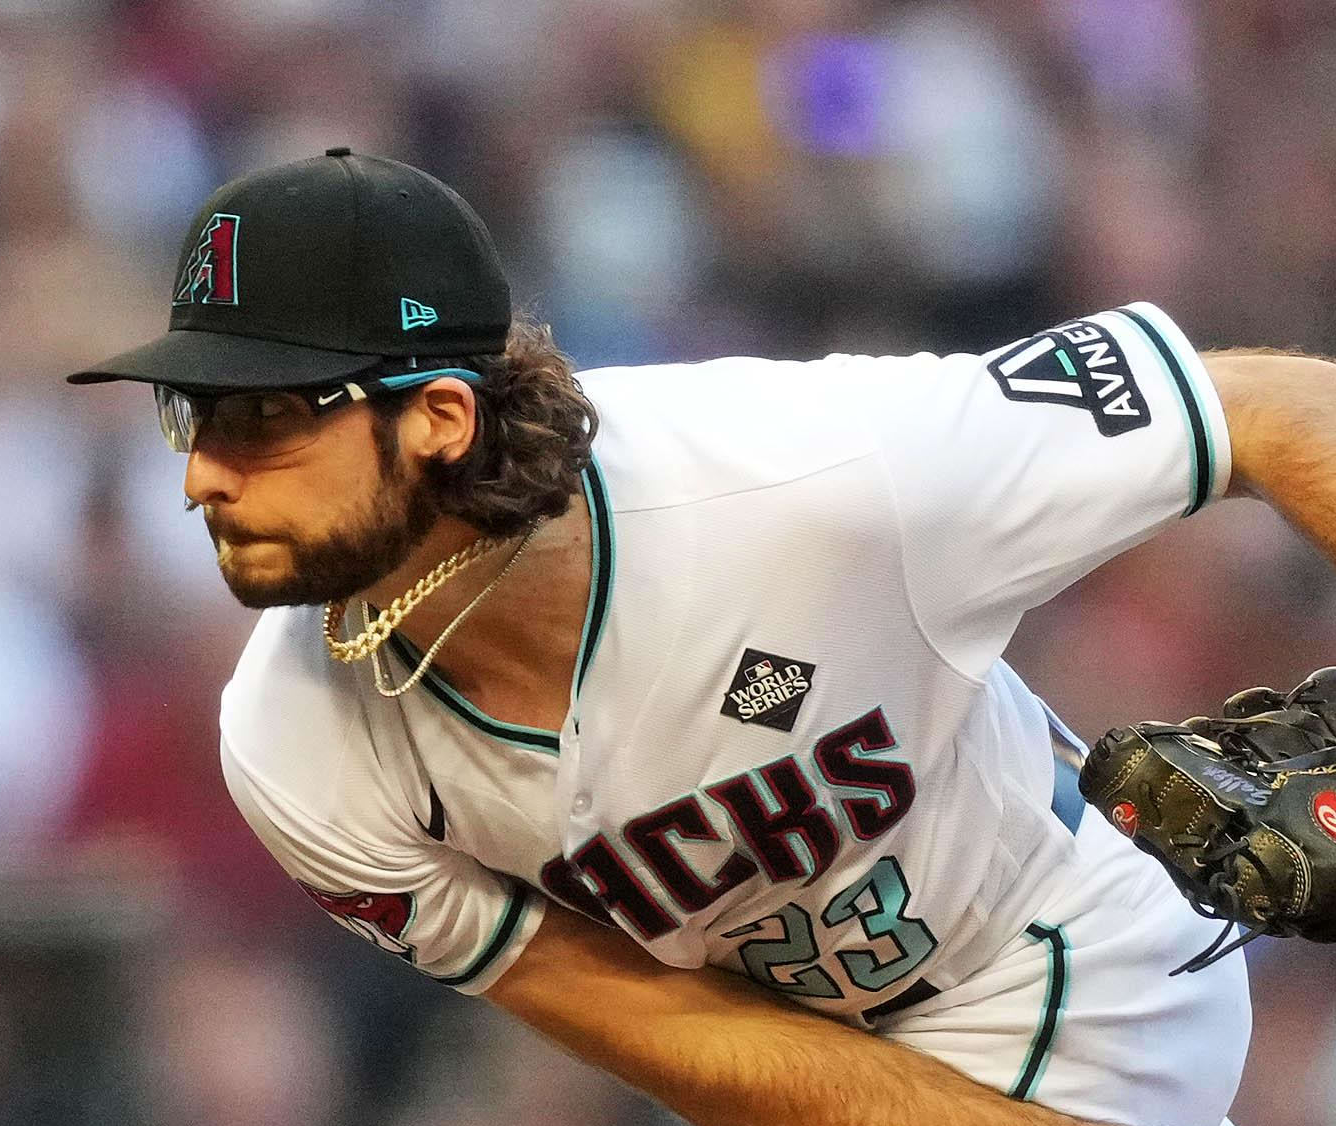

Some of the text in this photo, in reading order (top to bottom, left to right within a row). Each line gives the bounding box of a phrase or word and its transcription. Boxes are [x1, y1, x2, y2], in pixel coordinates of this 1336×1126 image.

[729, 664, 802, 705] WORLD
[738, 676, 810, 720] SERIES
[720, 855, 939, 1000] 23
